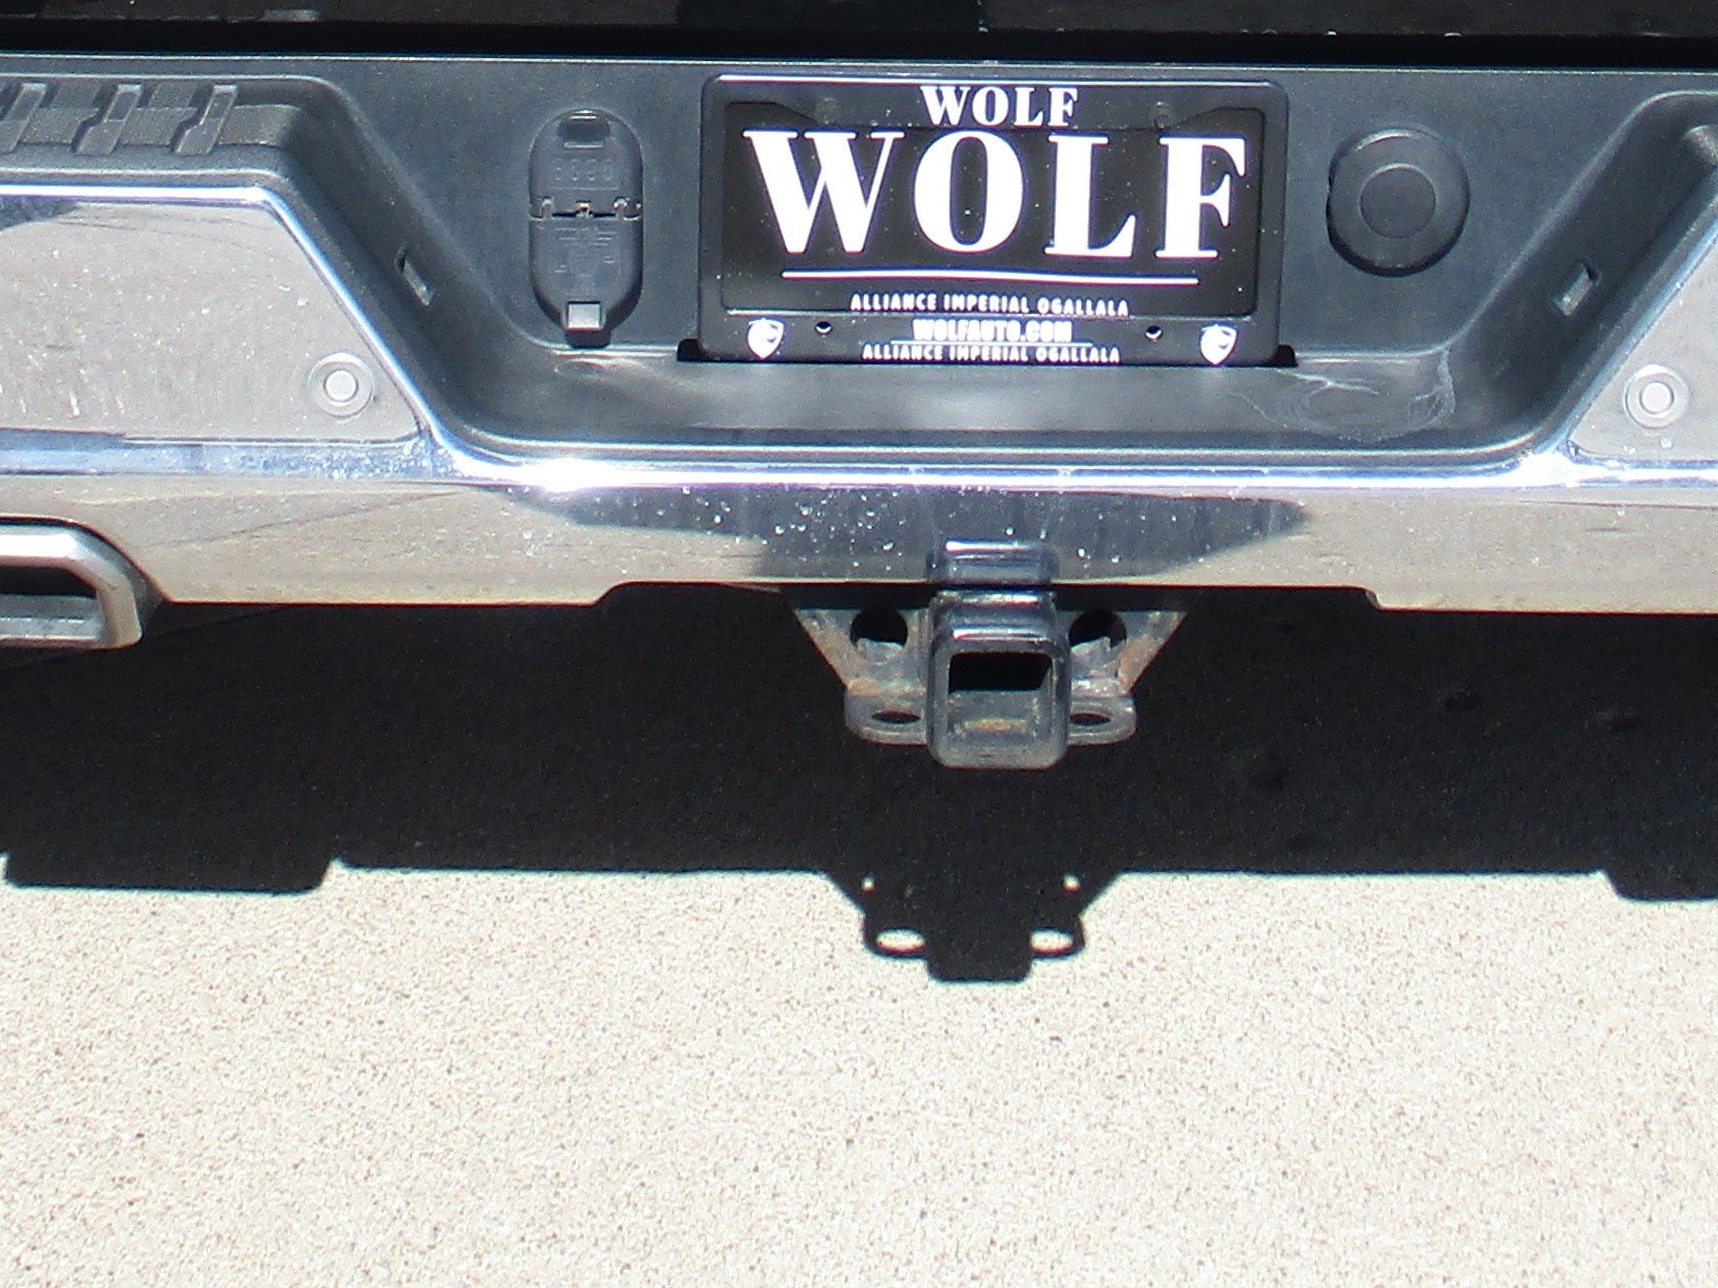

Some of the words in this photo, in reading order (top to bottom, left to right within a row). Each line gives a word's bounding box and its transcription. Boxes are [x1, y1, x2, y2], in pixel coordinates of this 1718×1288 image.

[919, 84, 1080, 127] WOLF
[742, 129, 1246, 260] WOLF
[849, 293, 938, 312] ALLIANCE
[943, 294, 1030, 314] IMPERIAL
[1036, 297, 1130, 317] OGALLALA
[912, 318, 1074, 343] WOLFAUTO.COM
[861, 343, 944, 362] ALLIANCE
[949, 344, 1030, 363] IMPERIAL
[1035, 345, 1121, 364] OGALLALA
